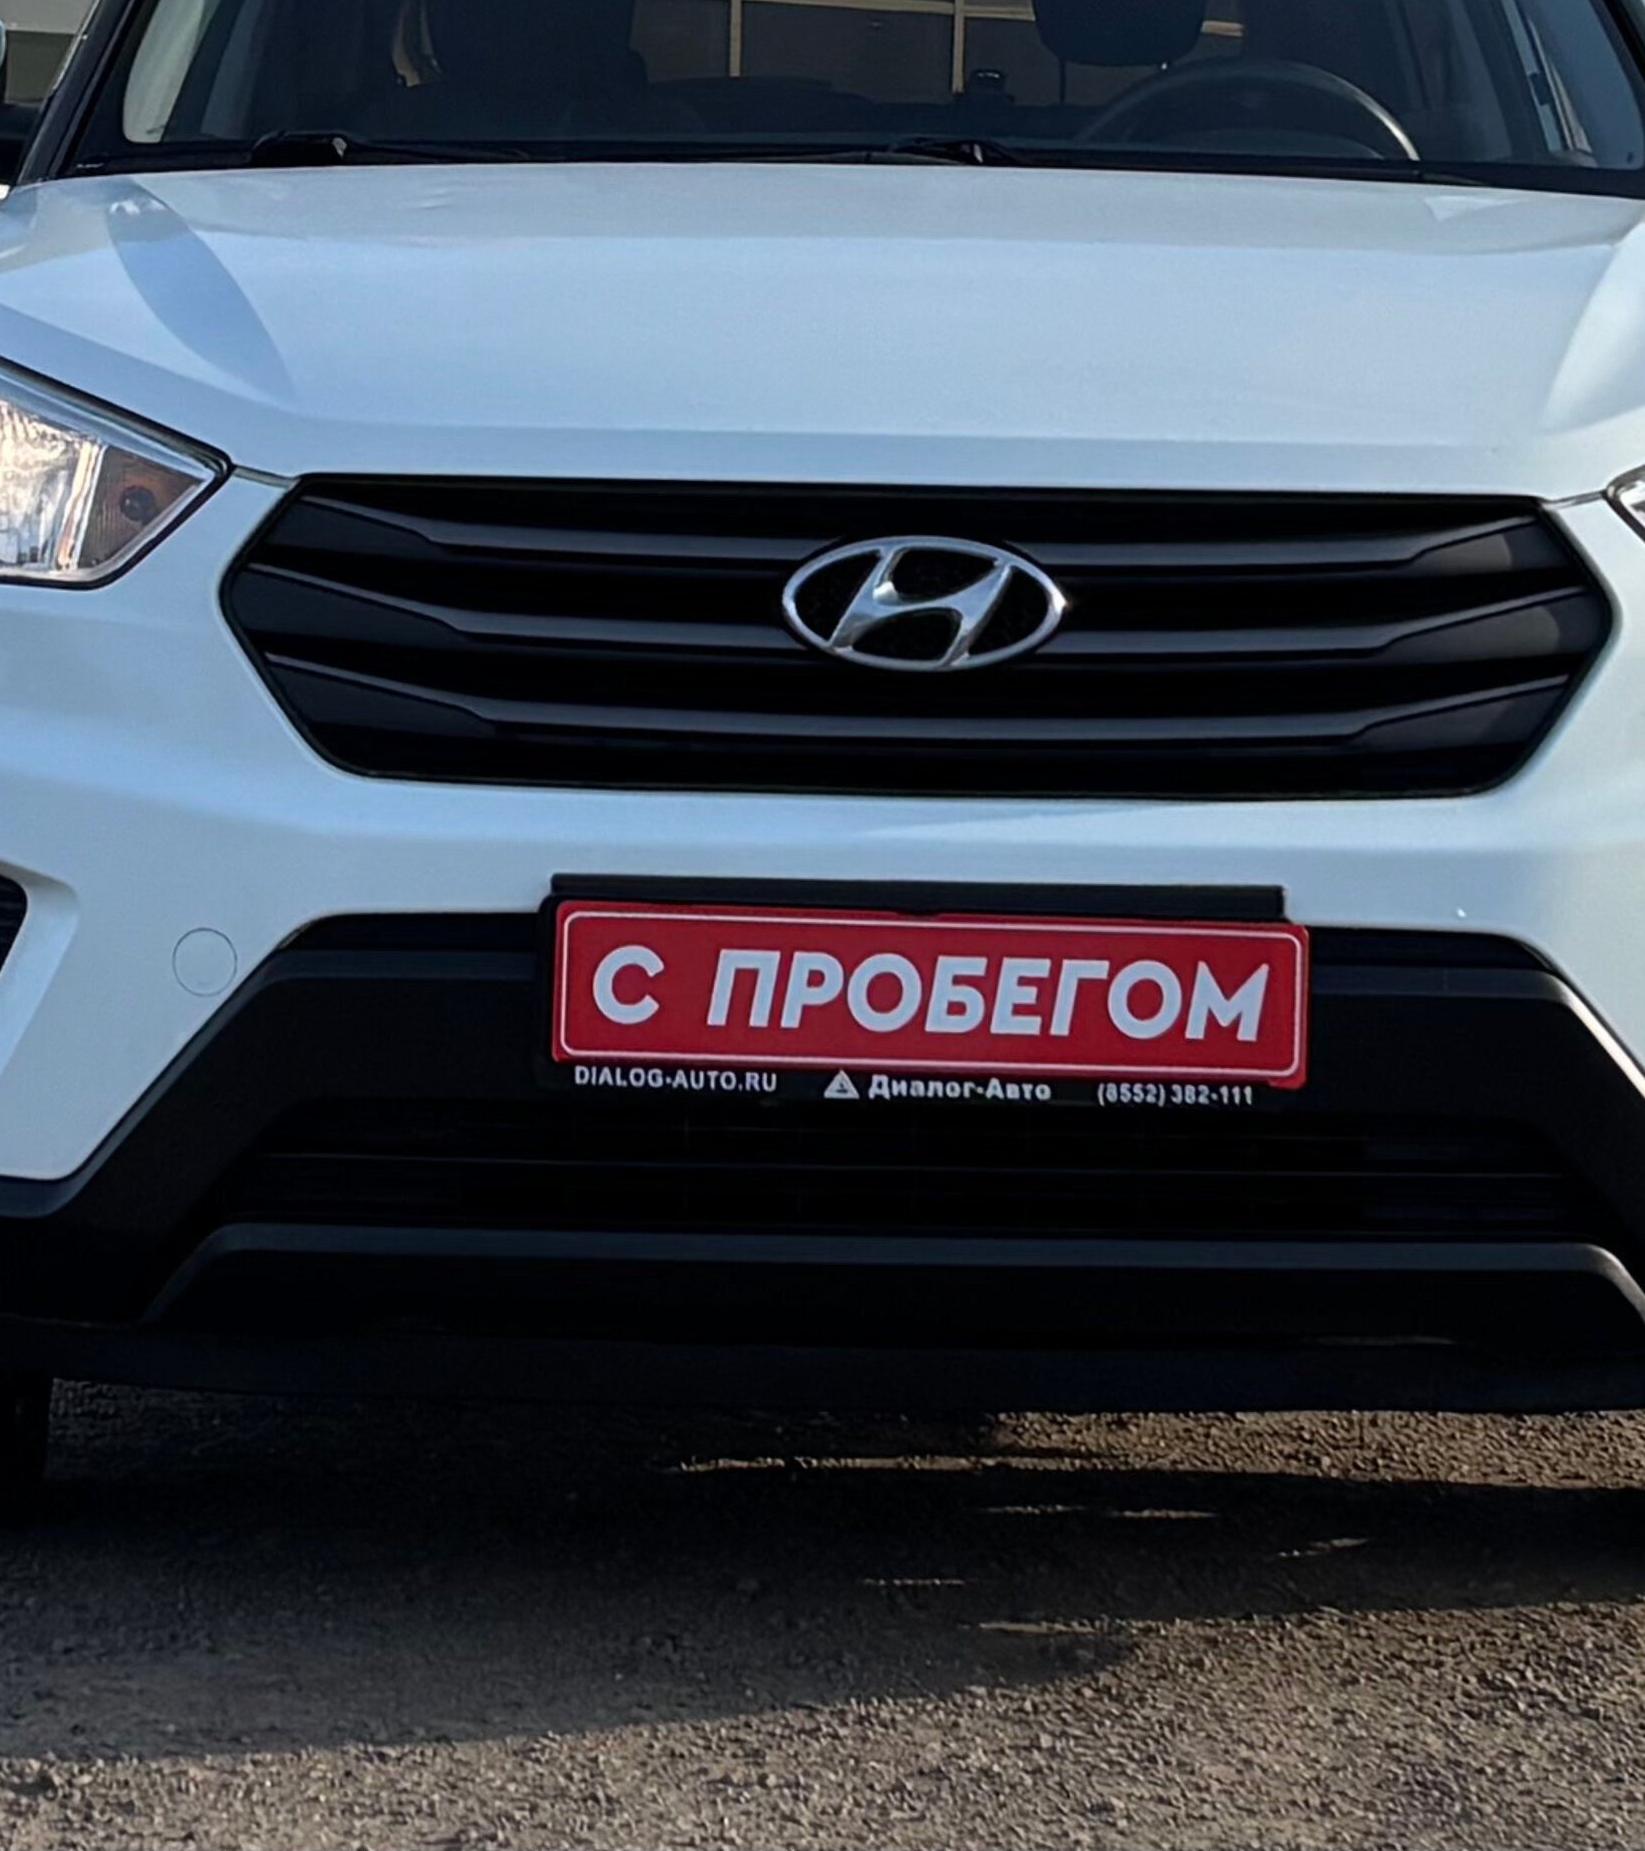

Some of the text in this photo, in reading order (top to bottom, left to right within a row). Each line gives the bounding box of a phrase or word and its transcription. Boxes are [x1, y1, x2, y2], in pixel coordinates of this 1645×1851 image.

[592, 944, 1270, 1043] С ПРОБЕГОМ
[574, 1065, 1253, 1108] DIALOG-AUTO.RU Диалог-Авто (8552) 382-111
